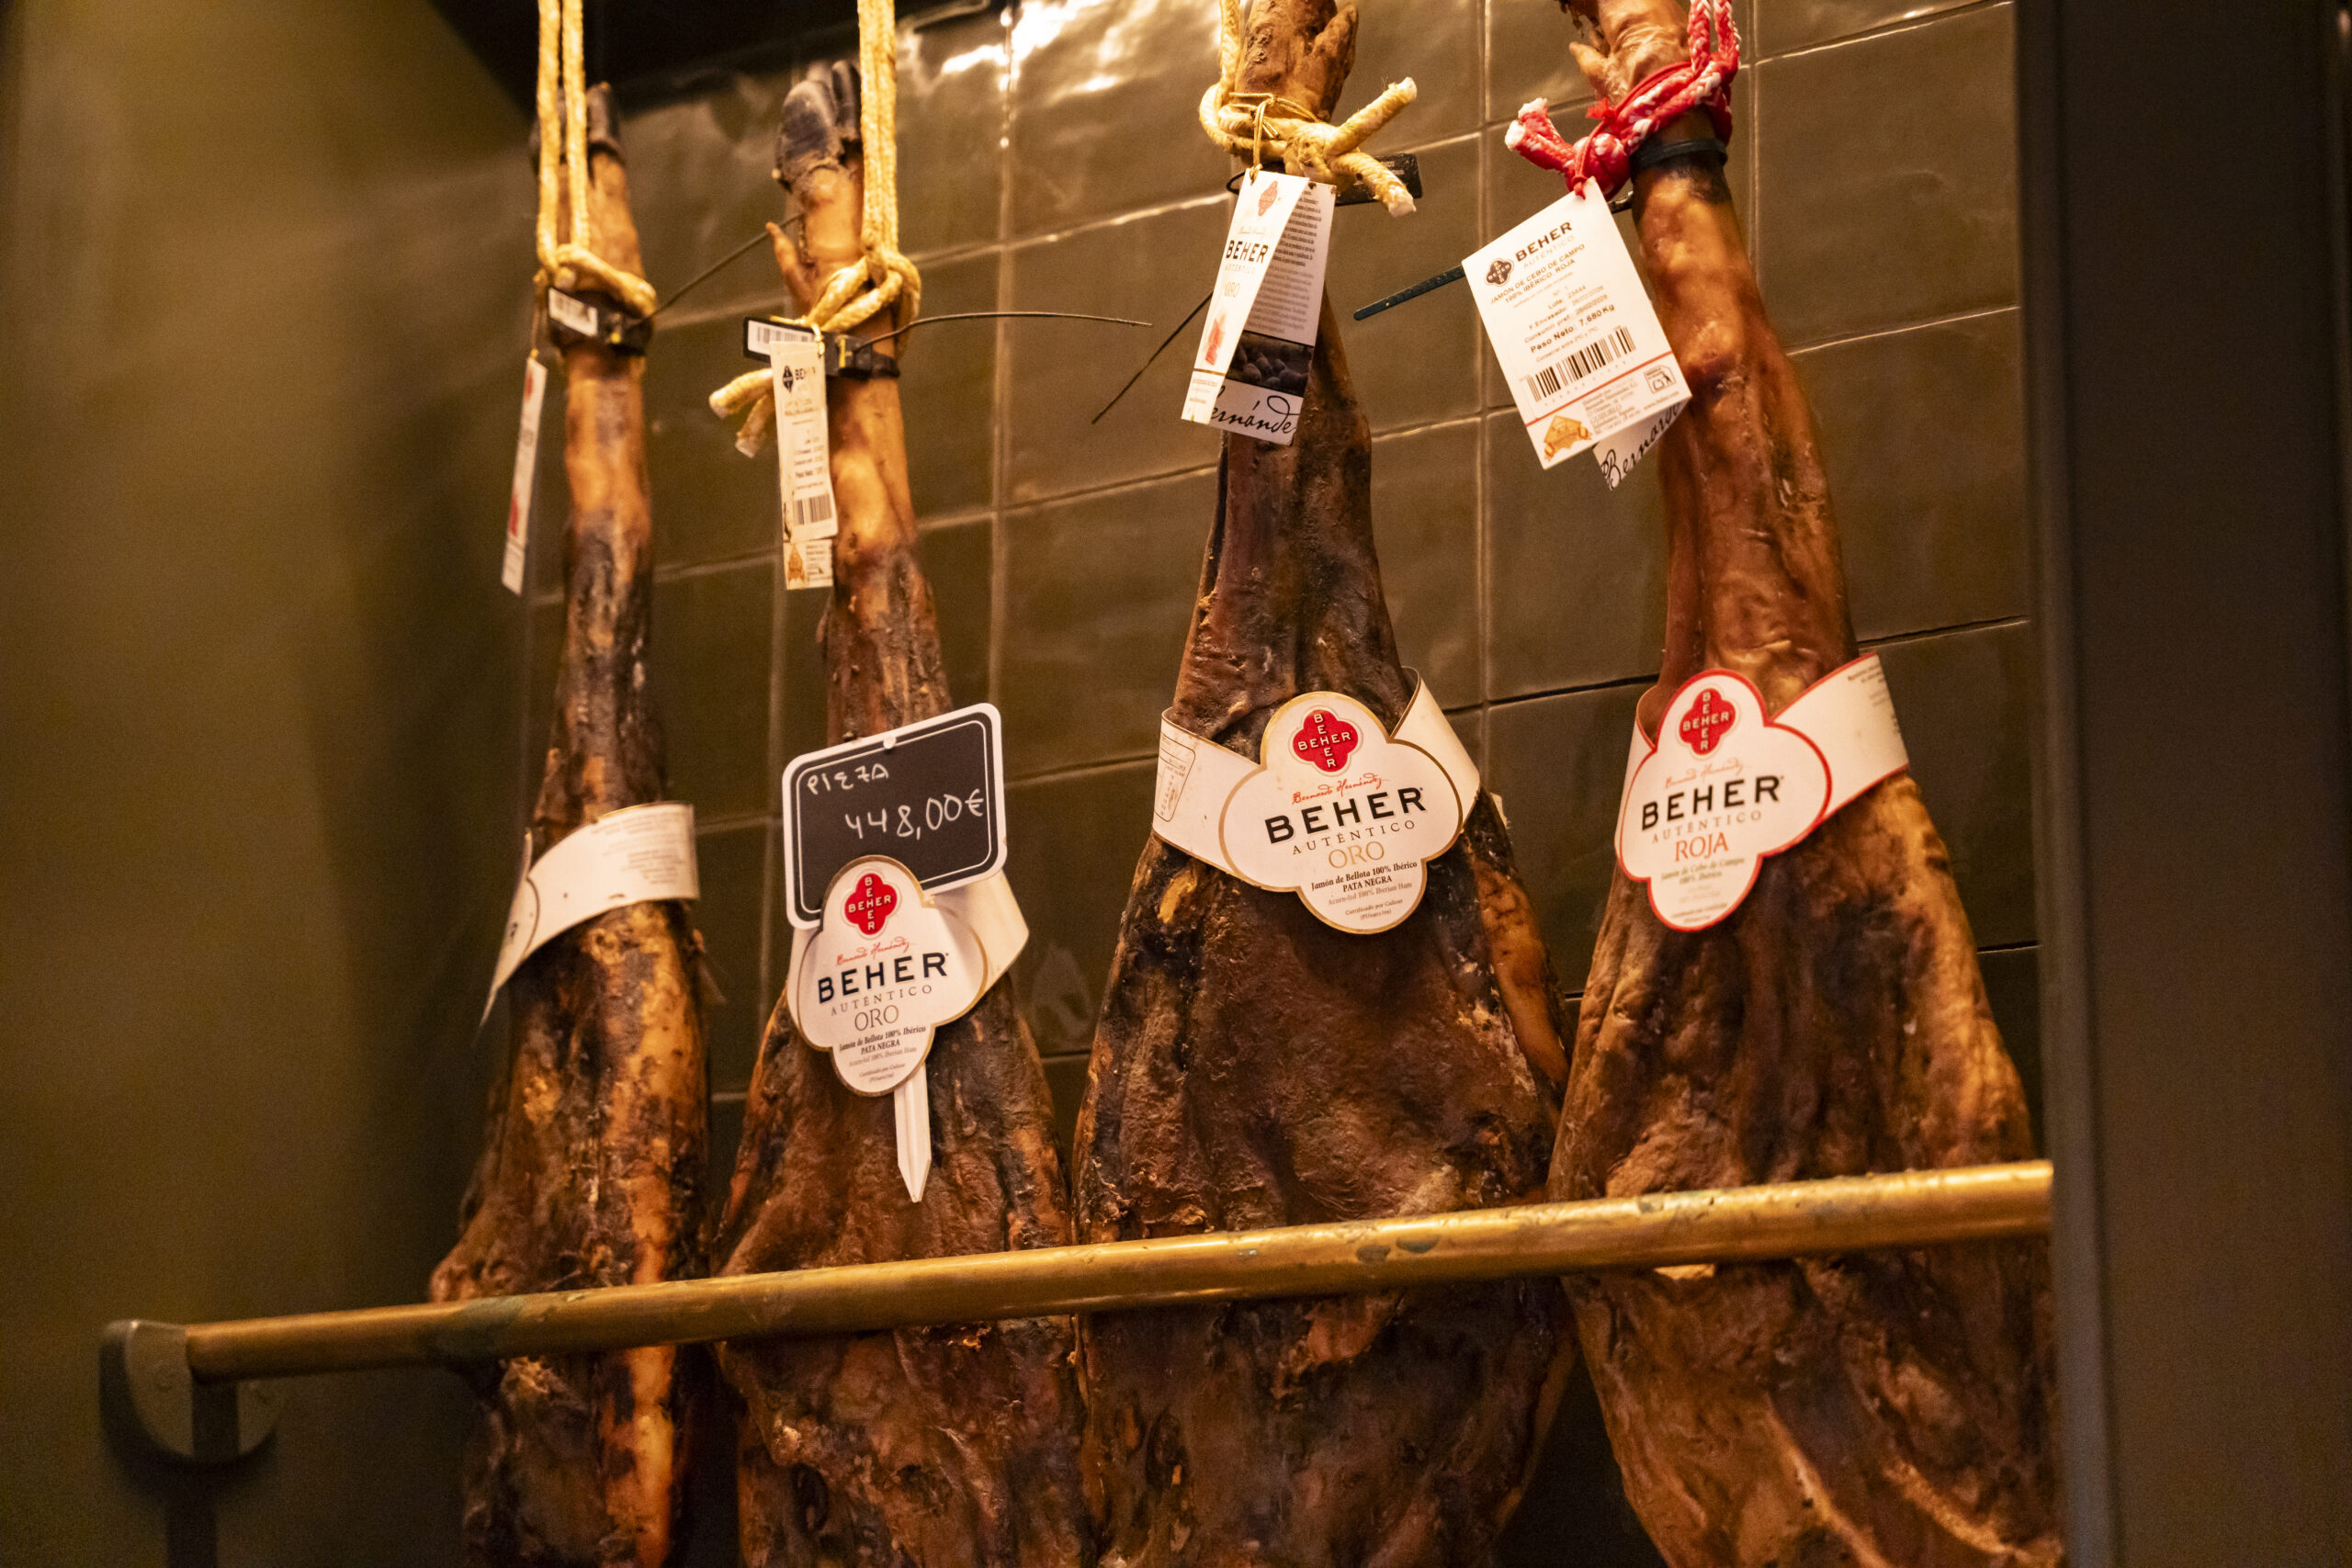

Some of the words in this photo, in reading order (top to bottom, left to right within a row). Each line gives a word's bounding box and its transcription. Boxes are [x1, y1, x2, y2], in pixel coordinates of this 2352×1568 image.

[1226, 240, 1269, 264] BEHER
[1516, 221, 1573, 262] BEHER
[1515, 279, 1525, 288] DE
[1526, 268, 1546, 282] CEBO
[1547, 259, 1558, 269] DE
[1559, 243, 1586, 263] CAMPO
[1555, 259, 1575, 273] ROJA
[1682, 711, 1730, 732] BEHER
[1297, 731, 1352, 750] BEHER
[1314, 714, 1337, 768] BEHER
[844, 788, 985, 840] 448,00€
[1265, 787, 1426, 844] BEHER
[1642, 775, 1780, 831] BEHER
[1293, 819, 1415, 855] AUTÉNTICO
[1675, 831, 1729, 862] ROJA
[1328, 841, 1385, 869] ORO
[1311, 878, 1334, 891] Jamón
[1335, 875, 1344, 884] de
[1346, 870, 1371, 882] Bellota
[1373, 865, 1392, 876] 100%
[1393, 862, 1418, 872] Ibérico
[1342, 882, 1363, 893] PATA
[1364, 875, 1393, 887] NEGRA
[848, 895, 892, 913] BEHER
[865, 876, 876, 931] BEHER
[818, 952, 947, 1004] BEHER
[831, 984, 933, 1016] AUTÉNTICO
[854, 1004, 899, 1032] ORO
[861, 1045, 876, 1055] PATA
[877, 1039, 900, 1050] NEGRA
[885, 1029, 901, 1039] 100%
